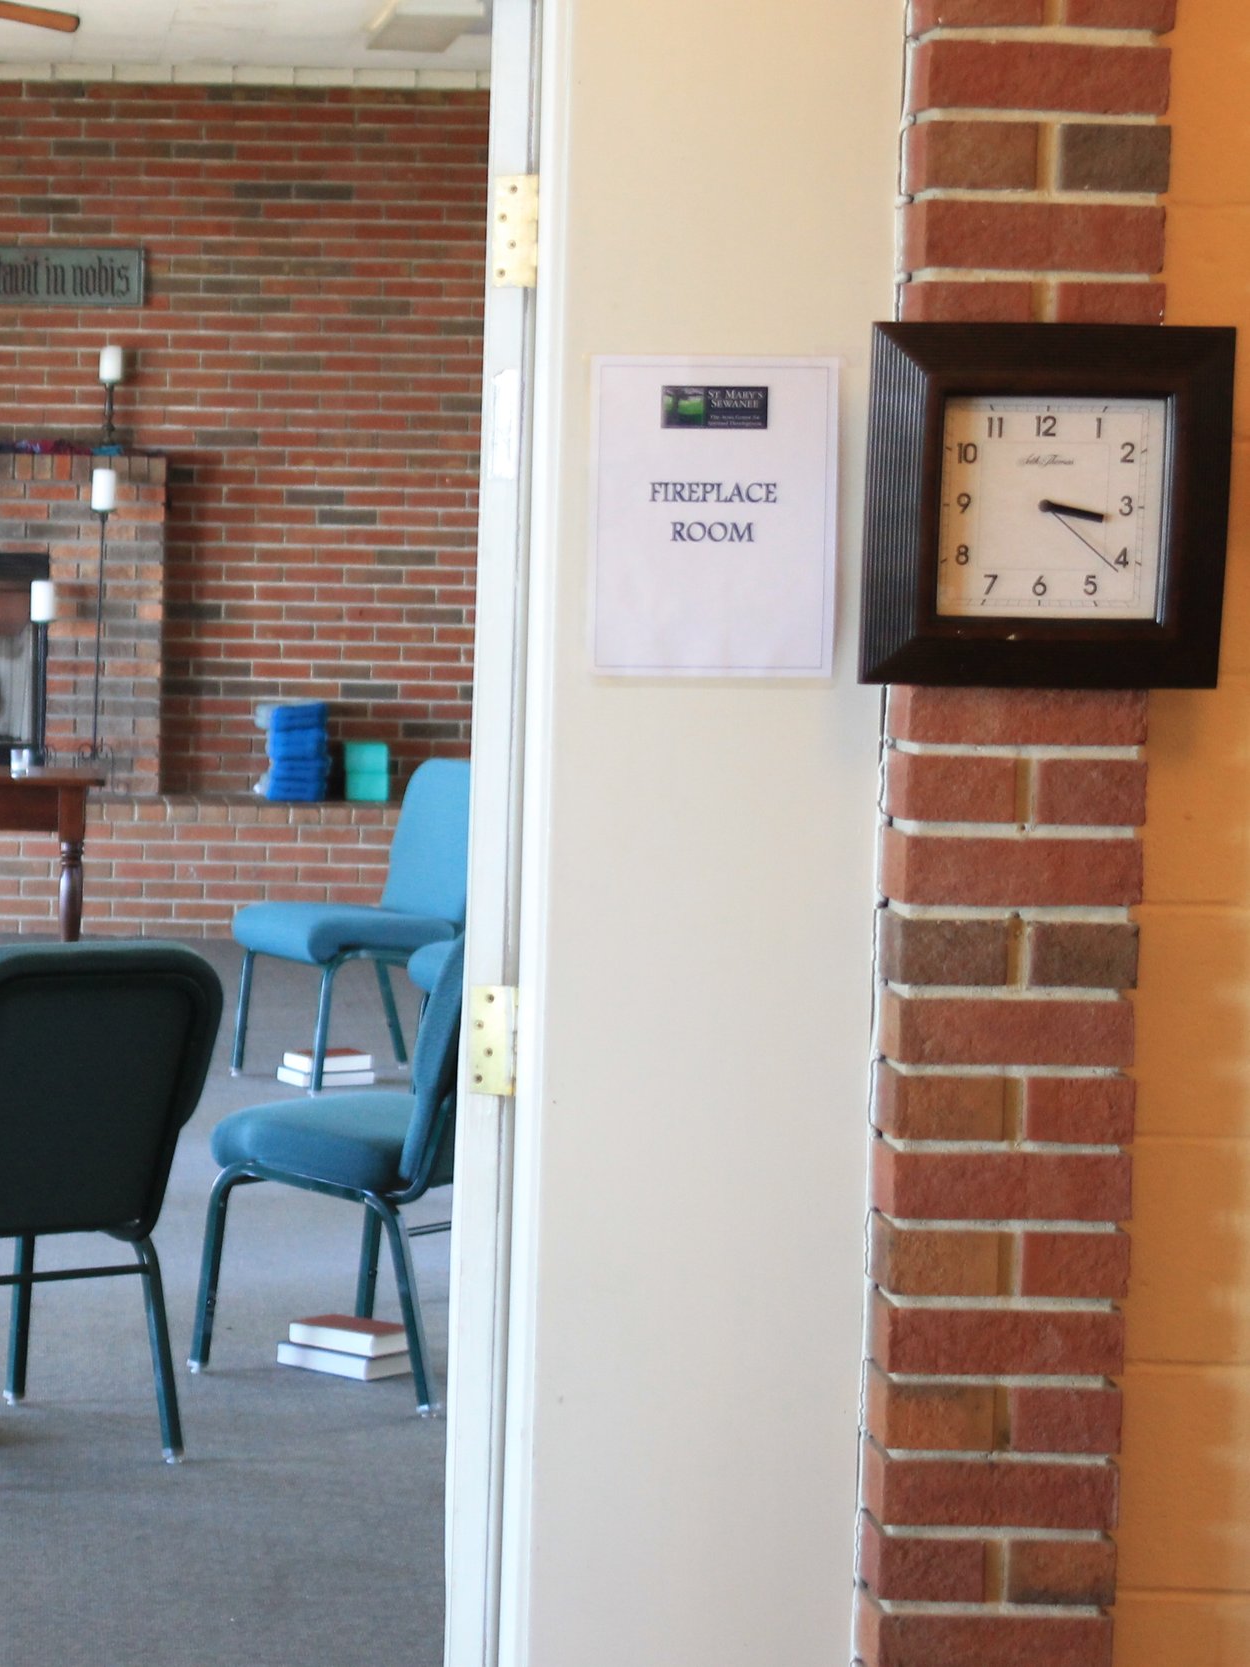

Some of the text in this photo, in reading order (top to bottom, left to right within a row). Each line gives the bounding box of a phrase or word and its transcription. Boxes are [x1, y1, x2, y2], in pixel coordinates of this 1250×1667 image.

[45, 256, 66, 296] in
[72, 255, 132, 298] nobis
[988, 417, 1003, 438] 11
[1036, 415, 1056, 437] 12
[1096, 417, 1103, 439] 1
[957, 442, 977, 464] 10
[1121, 442, 1135, 463] 2
[650, 481, 777, 503] FIREPLACE
[957, 493, 971, 514] 9
[1119, 496, 1133, 516] 3
[670, 521, 755, 543] ROOM
[955, 544, 969, 565] 8
[1114, 547, 1129, 568] 4
[983, 573, 999, 596] 7
[1032, 576, 1047, 596] 6
[1084, 575, 1097, 595] 5
